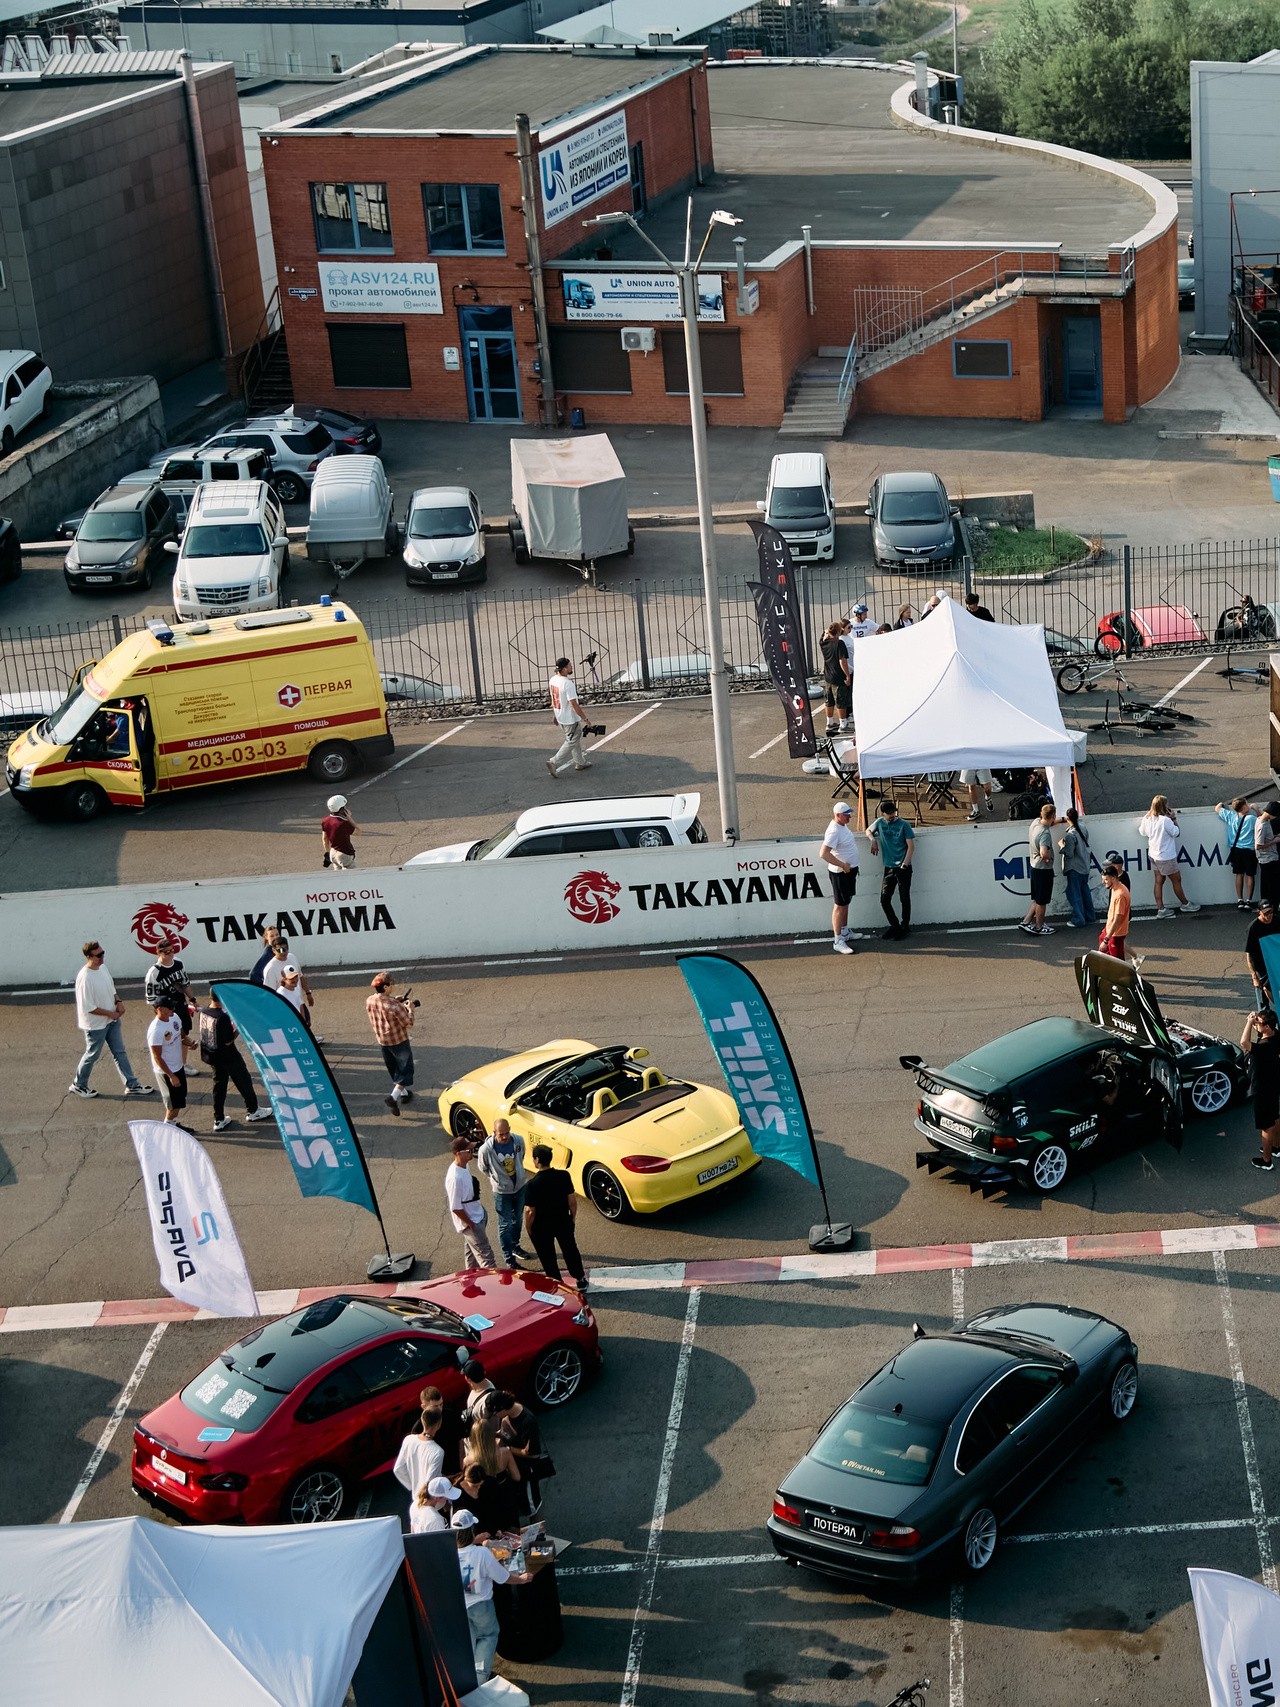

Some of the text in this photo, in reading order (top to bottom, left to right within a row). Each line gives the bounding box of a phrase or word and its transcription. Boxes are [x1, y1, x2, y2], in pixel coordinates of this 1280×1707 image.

[569, 133, 626, 171] АВТОМОБИЛИ СПЕЦТЕХНИКА
[570, 171, 579, 189] ИЗ
[579, 161, 603, 185] ЯПОНИИ
[609, 146, 628, 167] КОРЕИ
[546, 200, 569, 220] UNION AUTO
[350, 272, 435, 285] ASV124.RU
[626, 280, 675, 288] UNION AUTO
[328, 287, 437, 298] прокат автомобилей
[303, 679, 353, 696] ПЕРВАЯ
[187, 720, 329, 748] МЕДИЦИНСКАЯ ПОМОЩЬ
[107, 760, 133, 770] СКОРАЯ
[187, 740, 287, 771] 203-03-03
[737, 857, 813, 872] MOTOR OIL
[306, 888, 384, 904] MOTOR OIL
[628, 873, 824, 912] TAKAYAMA
[197, 904, 397, 943] TAKAYAMA
[1112, 1018, 1137, 1034] SKILL
[709, 1001, 788, 1137] SKILL
[750, 999, 803, 1138] FORGED WHEELS
[260, 1028, 339, 1169] SKILL
[288, 1026, 354, 1168] FORGED WHEELS
[1069, 1118, 1096, 1138] SKILL
[813, 1517, 856, 1538] ПОТЕРЯЛ
